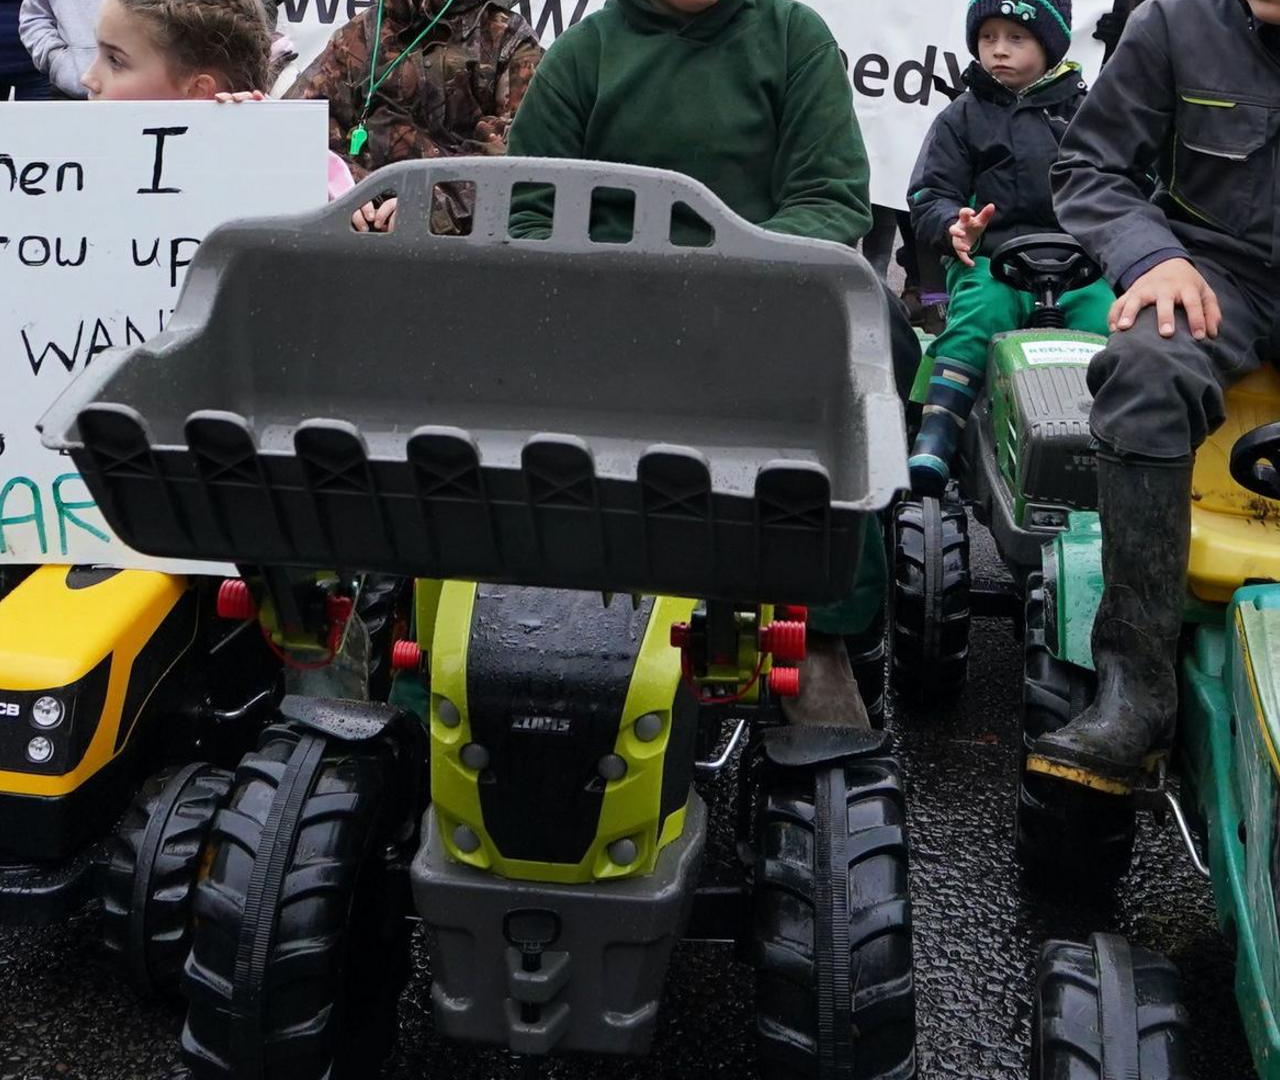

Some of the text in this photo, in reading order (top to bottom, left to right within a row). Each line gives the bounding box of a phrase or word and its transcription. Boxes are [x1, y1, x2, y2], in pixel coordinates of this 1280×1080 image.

[136, 126, 189, 195] I
[131, 236, 202, 287] up
[20, 309, 176, 377] WAN
